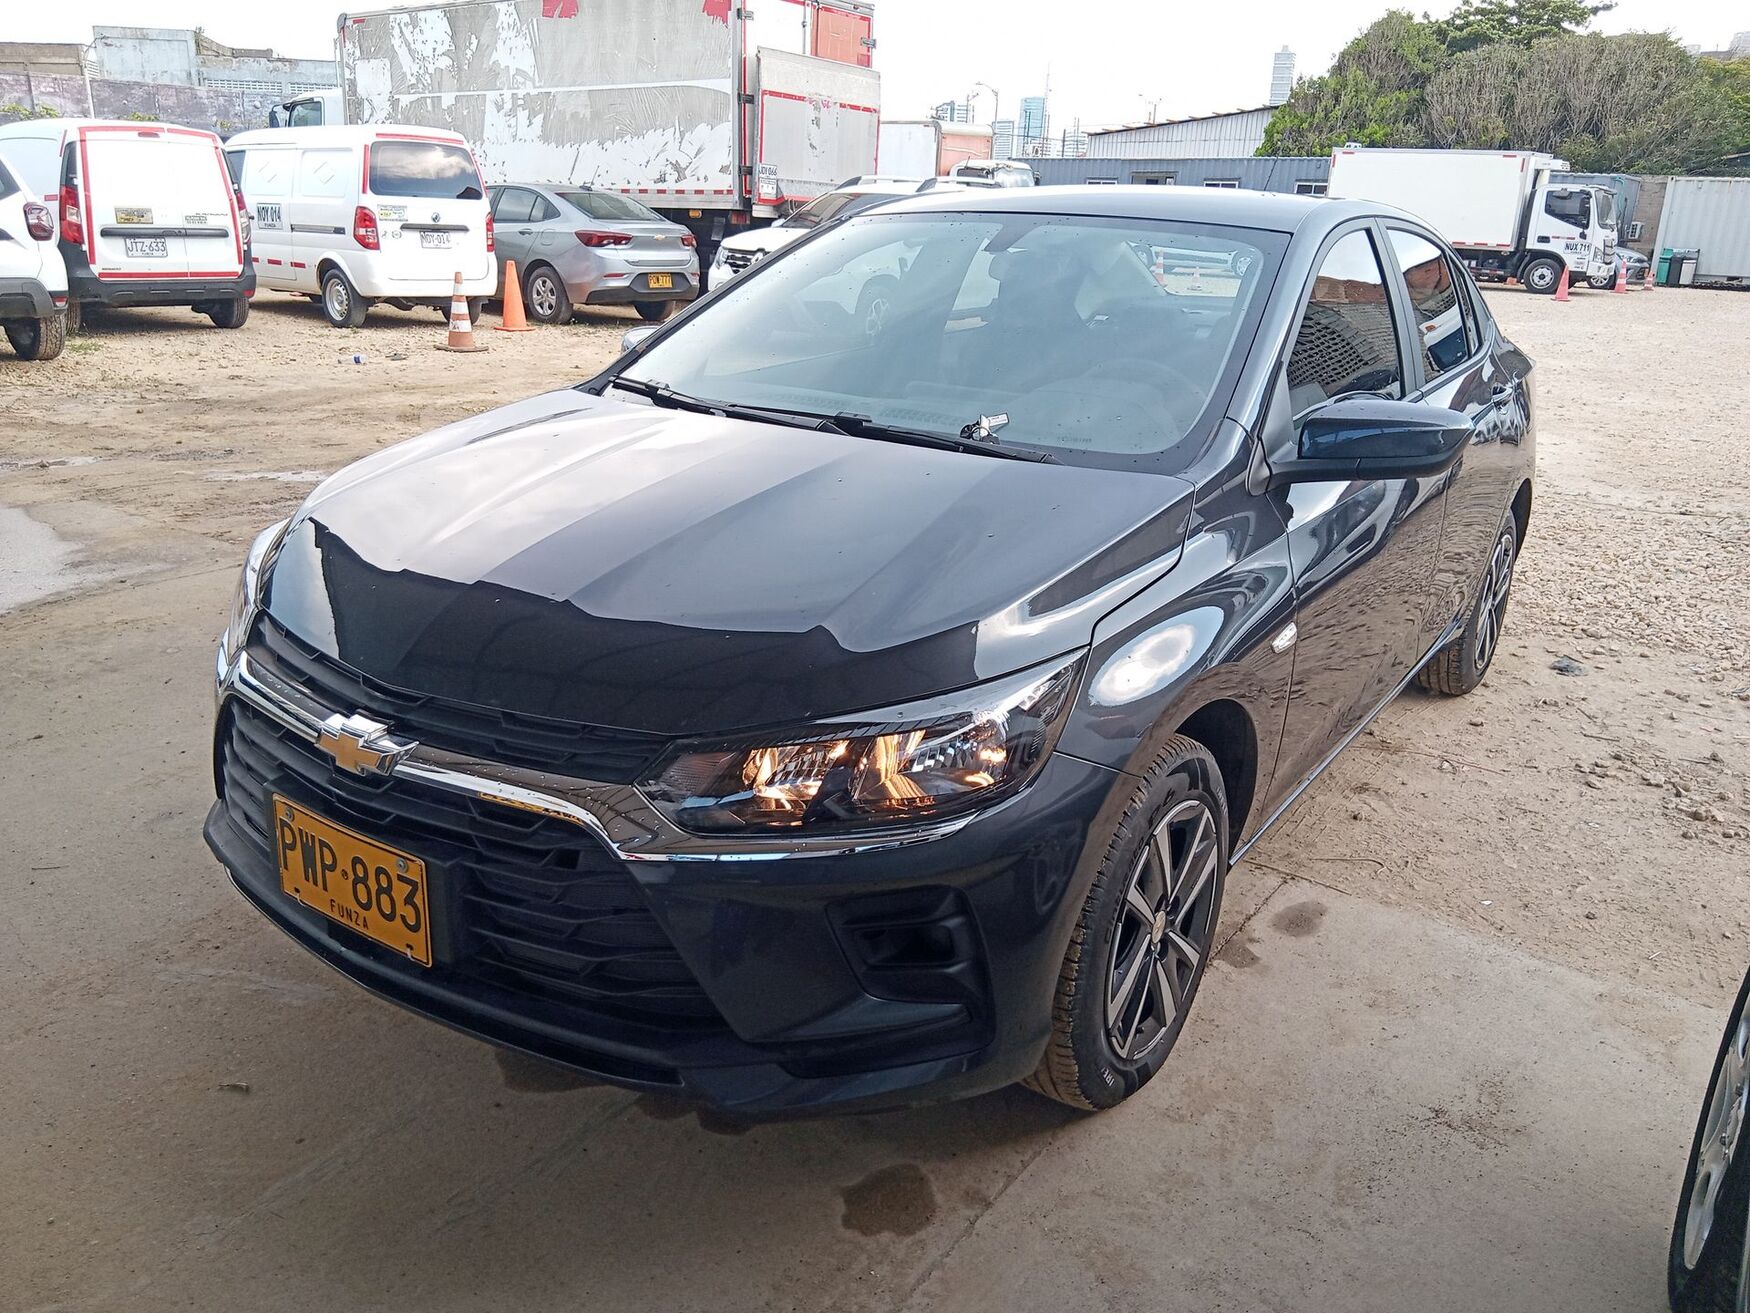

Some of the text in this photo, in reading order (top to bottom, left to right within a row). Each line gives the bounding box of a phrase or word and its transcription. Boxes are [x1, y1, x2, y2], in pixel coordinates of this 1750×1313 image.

[1565, 243, 1590, 251] NUX 711
[330, 898, 369, 931] FUNZA
